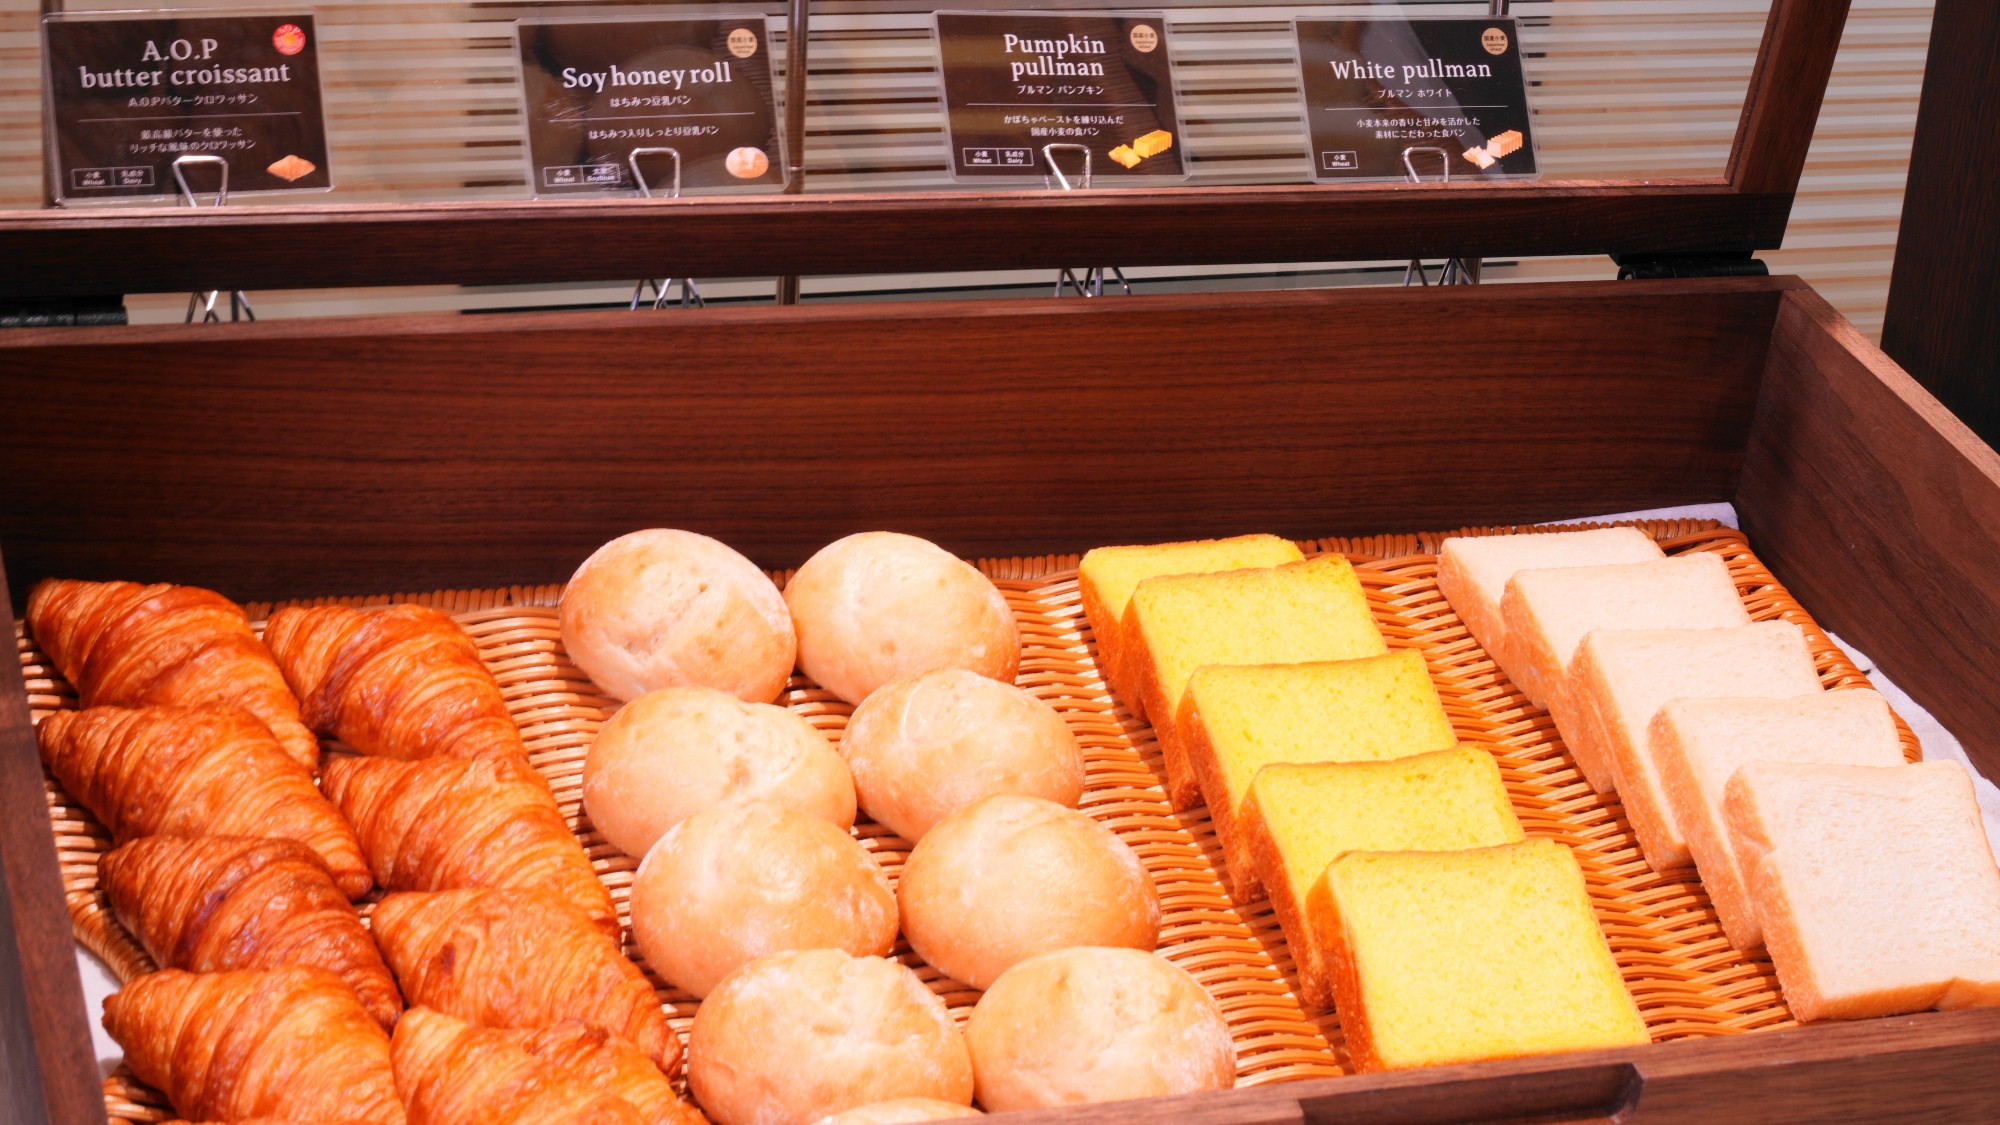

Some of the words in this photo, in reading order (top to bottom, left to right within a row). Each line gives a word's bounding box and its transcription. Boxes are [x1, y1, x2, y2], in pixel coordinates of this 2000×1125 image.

[141, 38, 218, 62] A.O.P
[1003, 34, 1106, 59] Pumpkin
[79, 65, 162, 89] butter
[170, 63, 291, 86] croissant
[562, 67, 608, 93] Soy
[609, 65, 686, 90] honey
[689, 61, 732, 83] roll
[1011, 56, 1105, 81] pullman
[1330, 60, 1395, 79] White
[1402, 58, 1492, 84] pullman
[610, 95, 692, 108] はちみつ豆乳パン
[1417, 88, 1452, 98] ホワイト
[1356, 117, 1480, 127] 小麦本来の香りと甘みを活かした
[588, 125, 720, 140] はちみつ入りしっとり豆乳パン
[1030, 127, 1100, 137] 国産小麦の食パン
[1375, 129, 1466, 139] 素材にこだわった食パン
